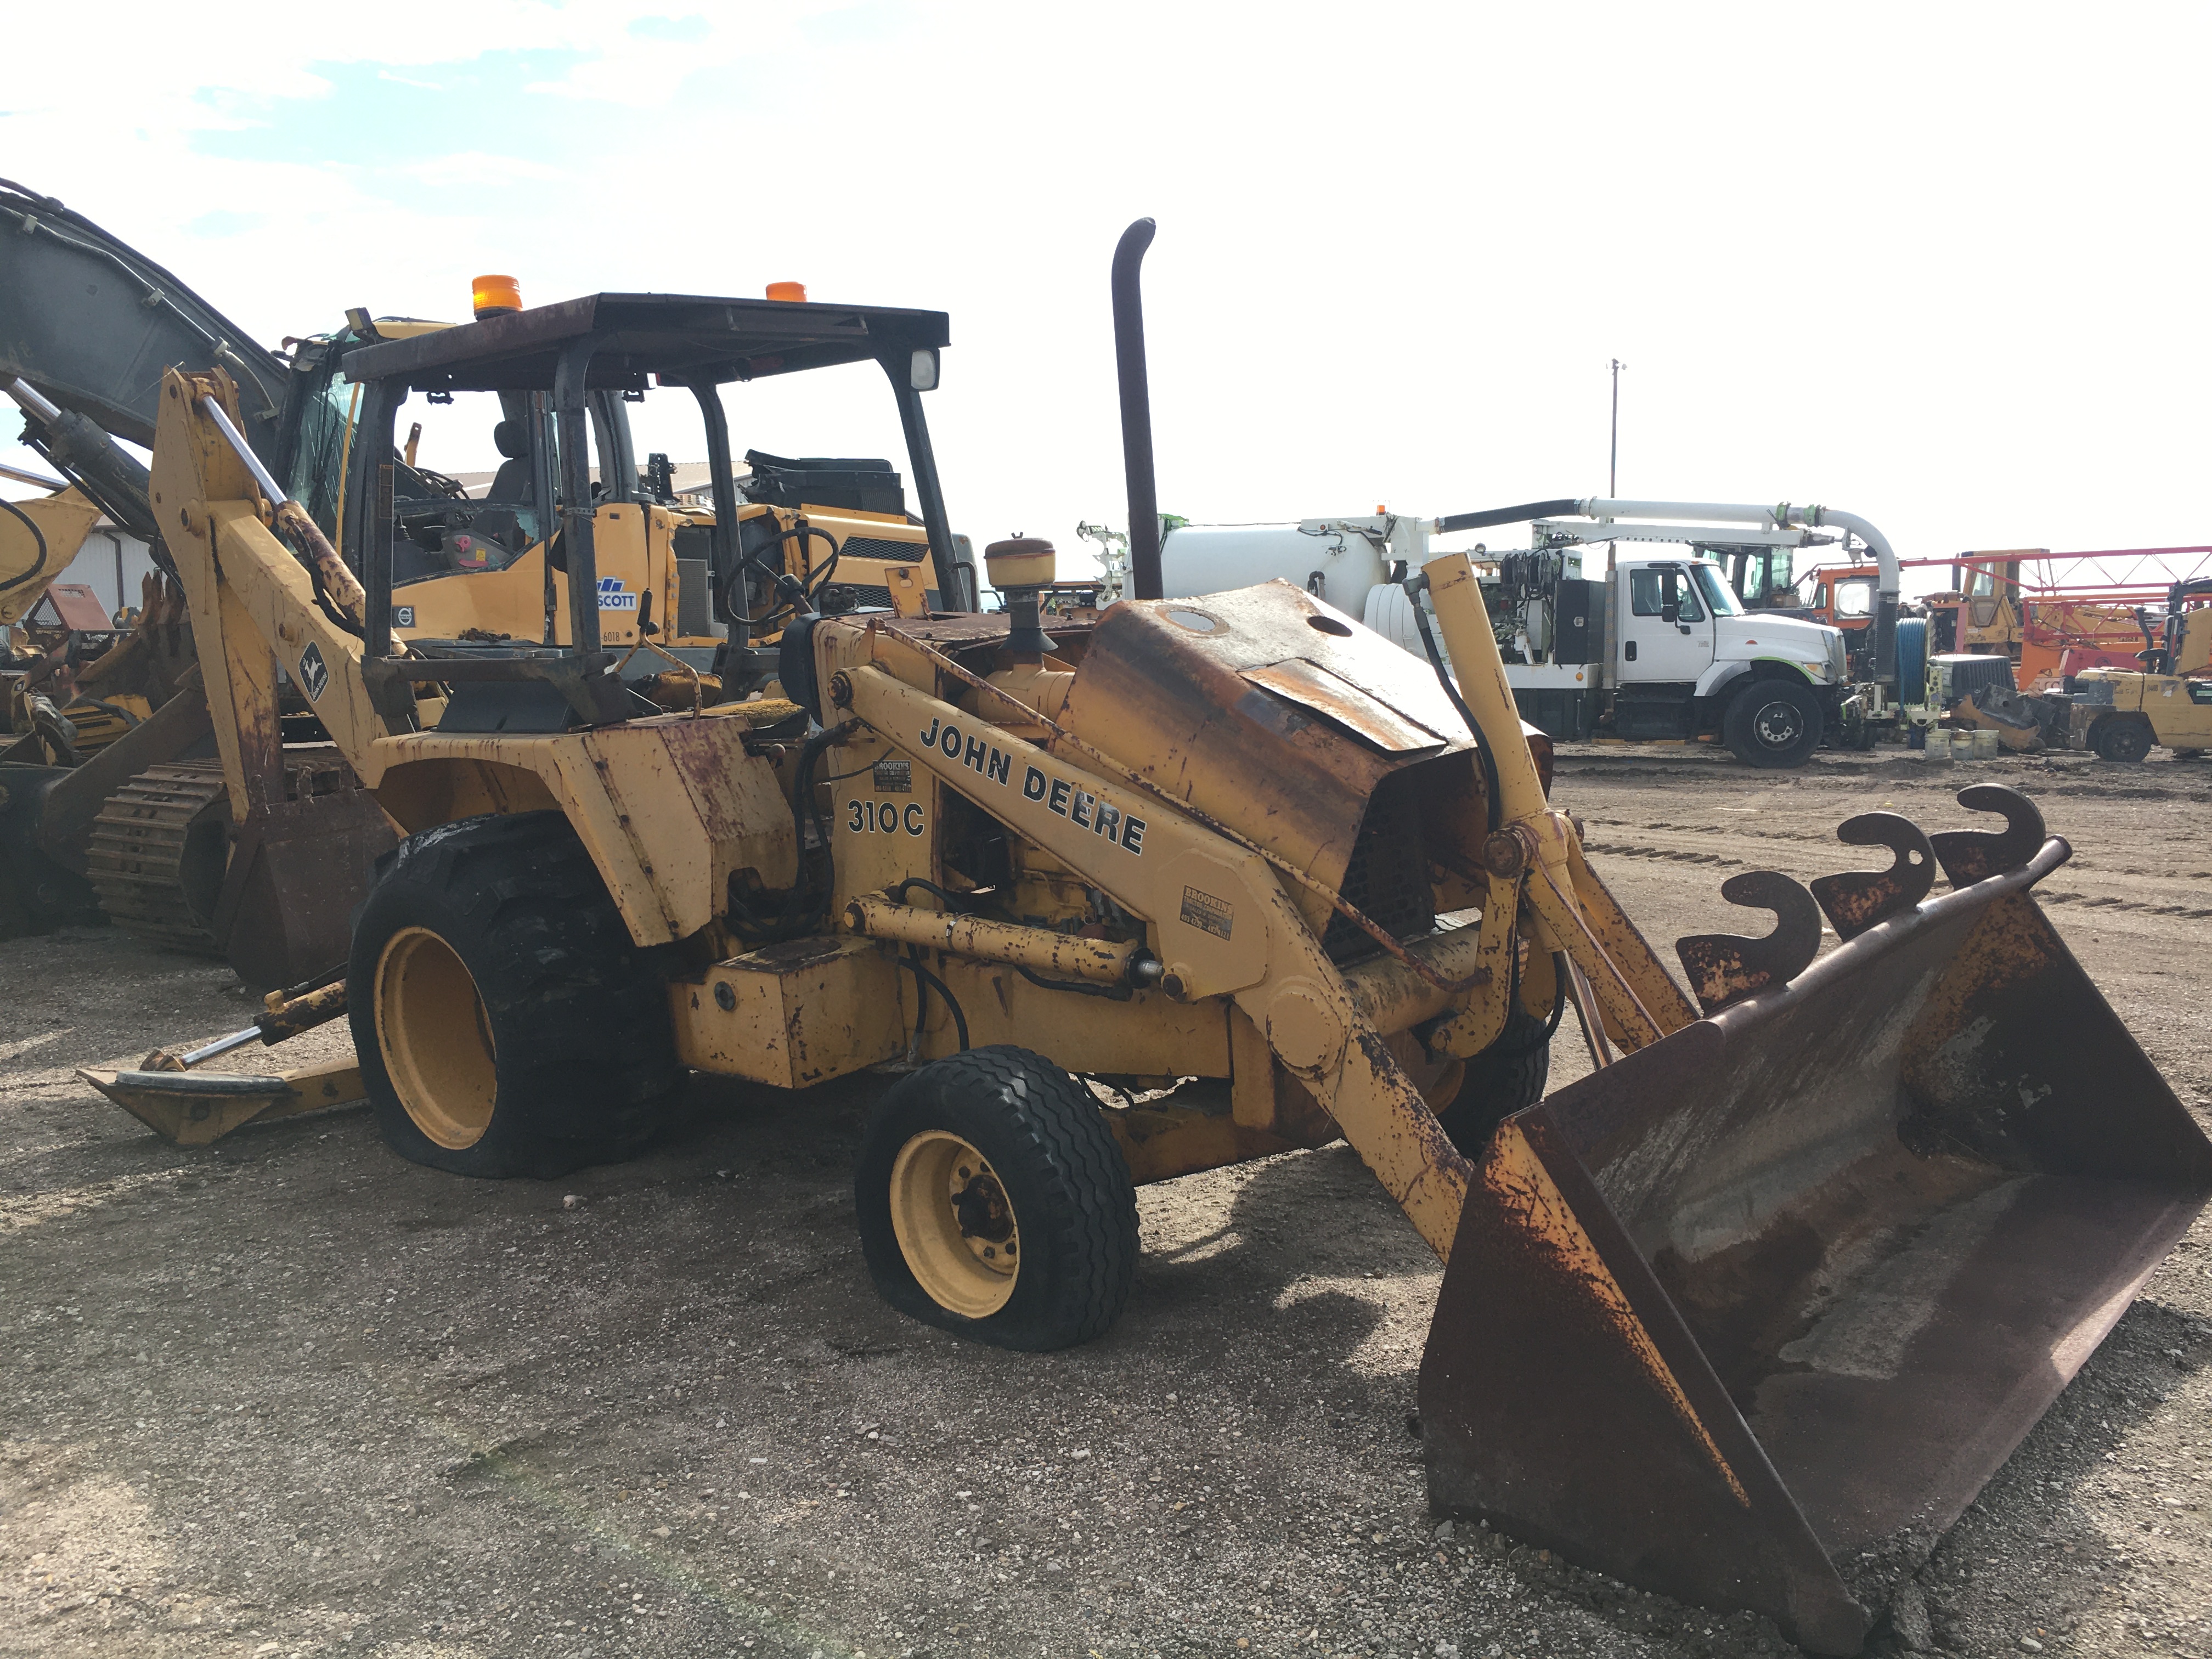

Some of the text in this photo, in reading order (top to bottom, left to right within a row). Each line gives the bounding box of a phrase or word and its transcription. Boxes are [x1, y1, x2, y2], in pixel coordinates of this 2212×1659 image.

[919, 717, 1147, 856] JOHN DEERE
[848, 799, 924, 837] 310C
[1185, 887, 1234, 915] BROOKINS
